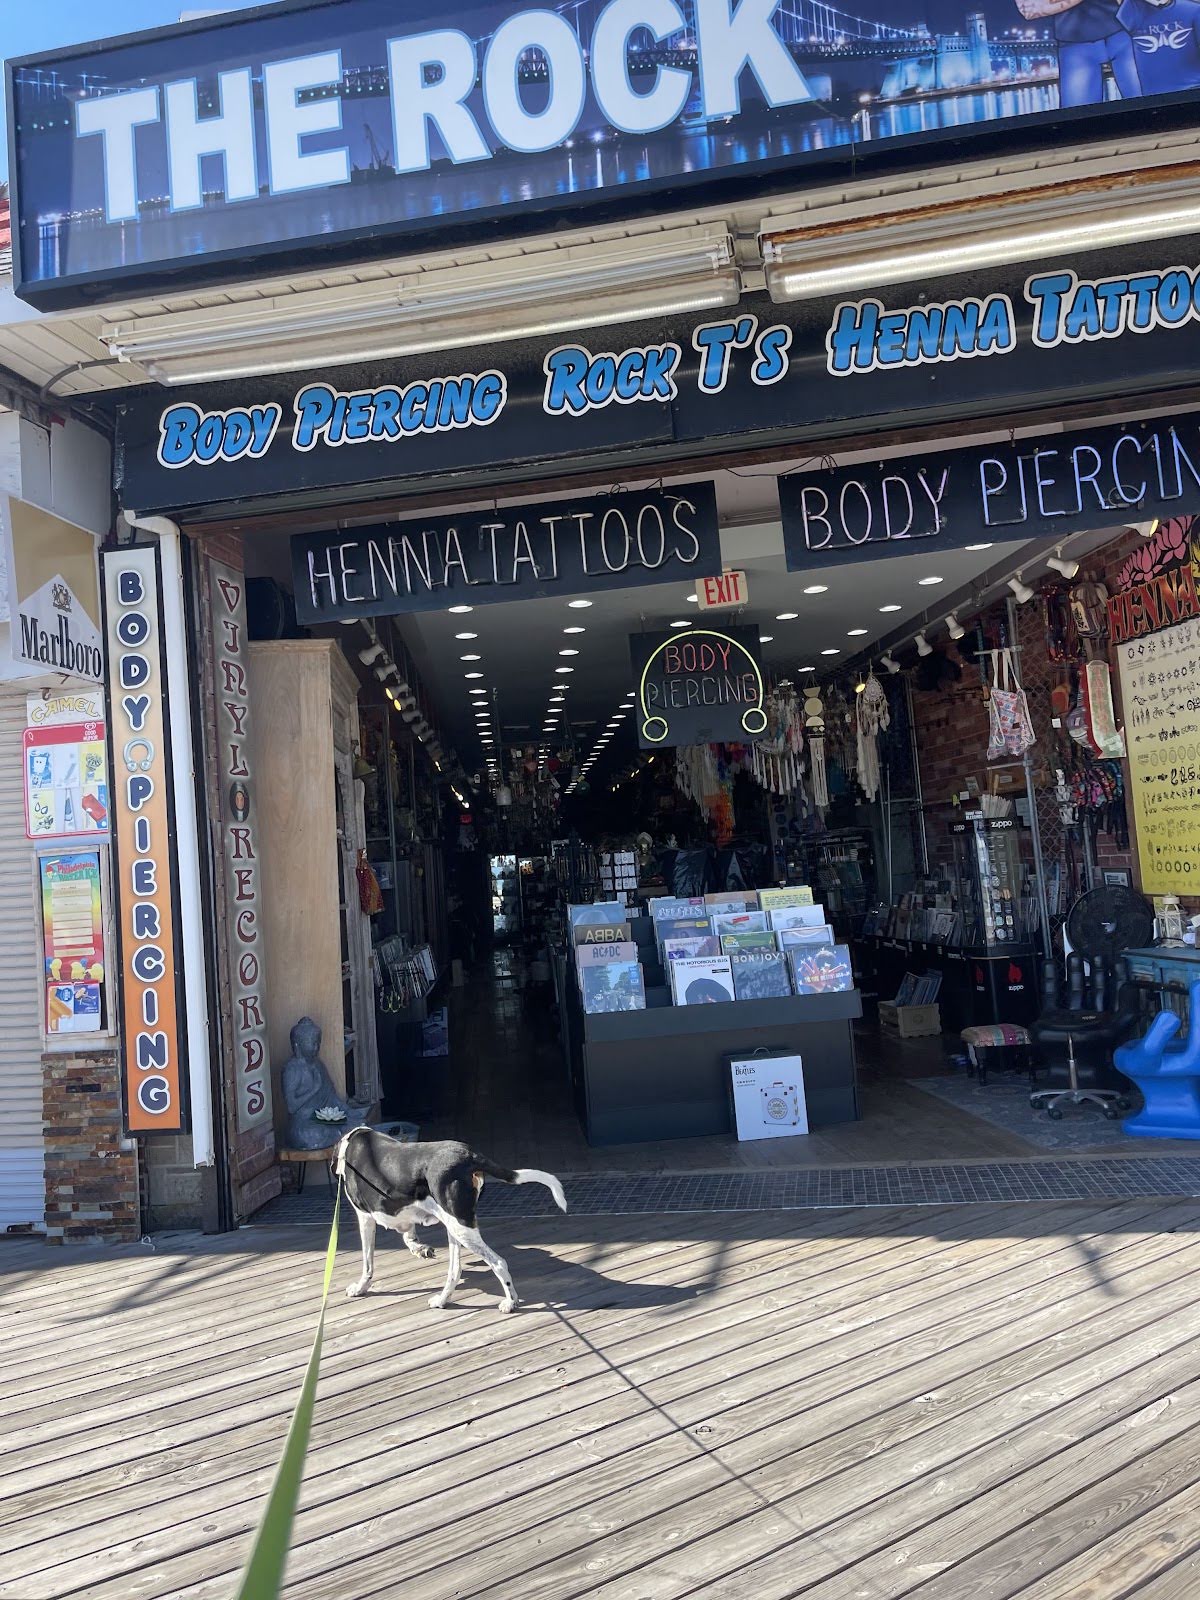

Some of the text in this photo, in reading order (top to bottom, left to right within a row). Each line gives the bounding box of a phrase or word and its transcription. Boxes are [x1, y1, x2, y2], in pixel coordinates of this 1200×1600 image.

[1149, 21, 1185, 35] ROCK
[75, 0, 813, 224] THE ROCK
[157, 402, 281, 468] BODY
[292, 369, 507, 451] PIERCING
[543, 344, 679, 416] ROCK
[826, 293, 1016, 377] HENNA
[1023, 264, 1200, 347] TATTO
[801, 466, 951, 550] BODY
[307, 499, 700, 608] HENNA TATTOOS
[703, 573, 740, 606] EXIT
[1107, 562, 1200, 644] HENNA
[19, 613, 102, 678] Marlboro
[665, 642, 731, 674] BODY
[31, 697, 100, 723] CAMEL
[646, 673, 757, 710] PIERCING
[117, 569, 171, 1115] BODY PIERCING
[217, 578, 265, 1116] VINYL RECORDS
[991, 820, 1013, 829] zippo
[585, 928, 626, 943] ABBA
[733, 954, 755, 963] BON
